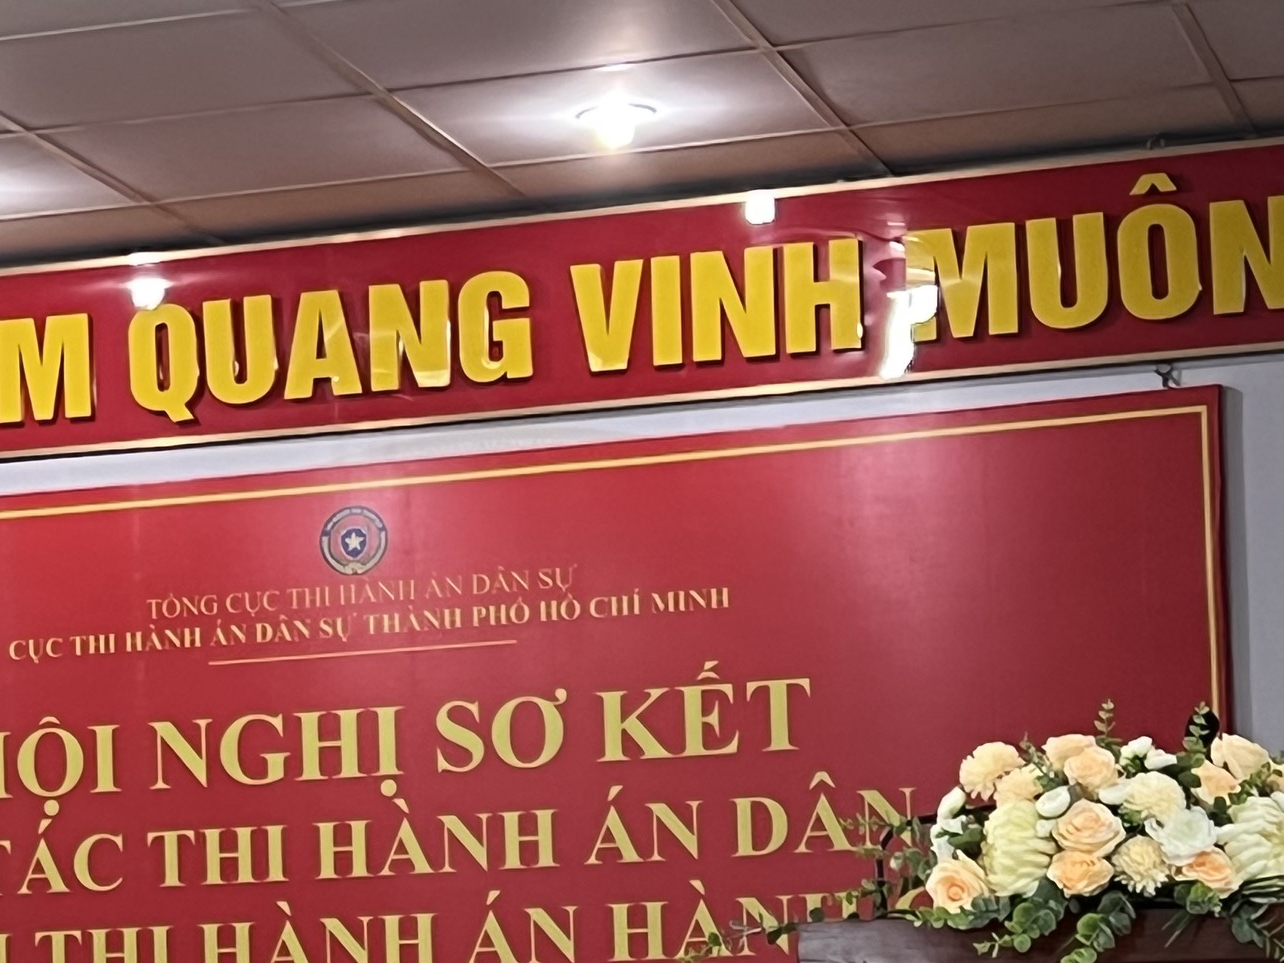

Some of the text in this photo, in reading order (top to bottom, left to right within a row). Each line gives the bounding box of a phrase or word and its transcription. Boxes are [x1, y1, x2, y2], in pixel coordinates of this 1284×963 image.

[127, 270, 534, 422] QUANG
[570, 238, 863, 372] VINH
[904, 172, 1284, 341] MUÔN
[8, 638, 64, 664] CỤC
[70, 632, 116, 656] THI
[125, 623, 202, 652] HÀNH
[211, 618, 247, 646] ÁN
[256, 614, 311, 644] DÂN
[319, 612, 357, 642] SỰ
[365, 603, 463, 634] THÀNH
[590, 587, 641, 619] CHÍ
[651, 586, 730, 614] MINH
[226, 589, 280, 617] CỤC
[287, 583, 331, 609] THI
[149, 705, 405, 797] NGHỊ
[435, 688, 568, 774] SƠ
[596, 660, 812, 763] KẾT
[148, 825, 289, 888] THI
[313, 798, 560, 880] HÀNH
[584, 785, 704, 866] ÁN
[732, 771, 918, 858] DÂN
